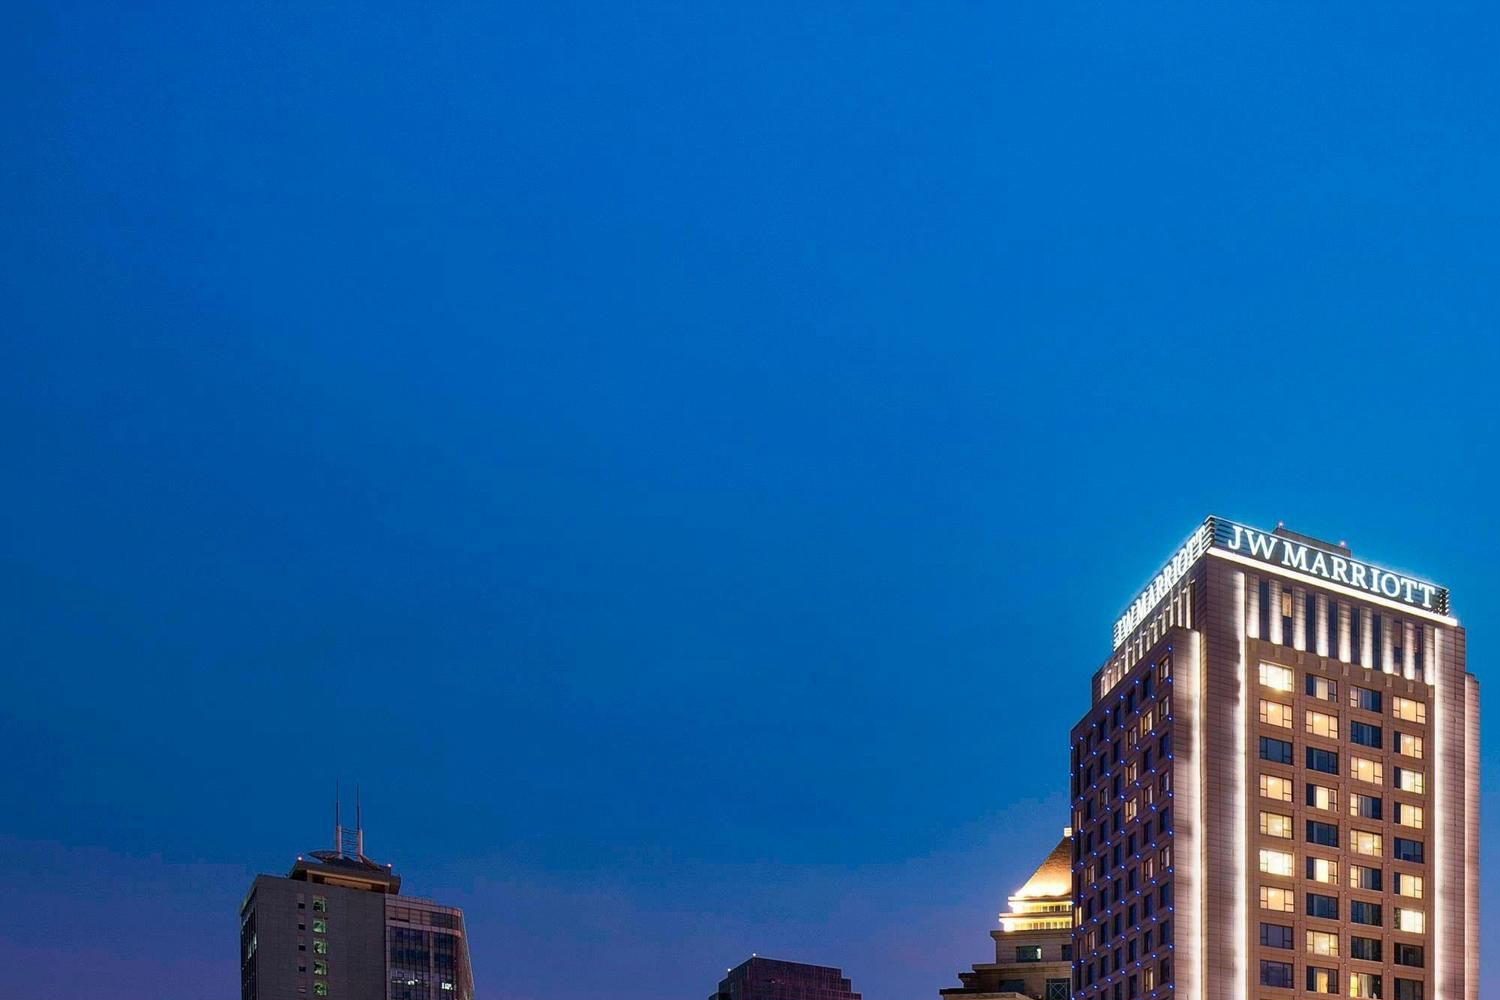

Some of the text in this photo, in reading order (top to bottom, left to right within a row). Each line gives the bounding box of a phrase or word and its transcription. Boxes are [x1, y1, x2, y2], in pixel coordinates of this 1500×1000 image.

[1135, 525, 1206, 621] MARRIOTT
[1227, 525, 1436, 609] JW MARRIOTT
